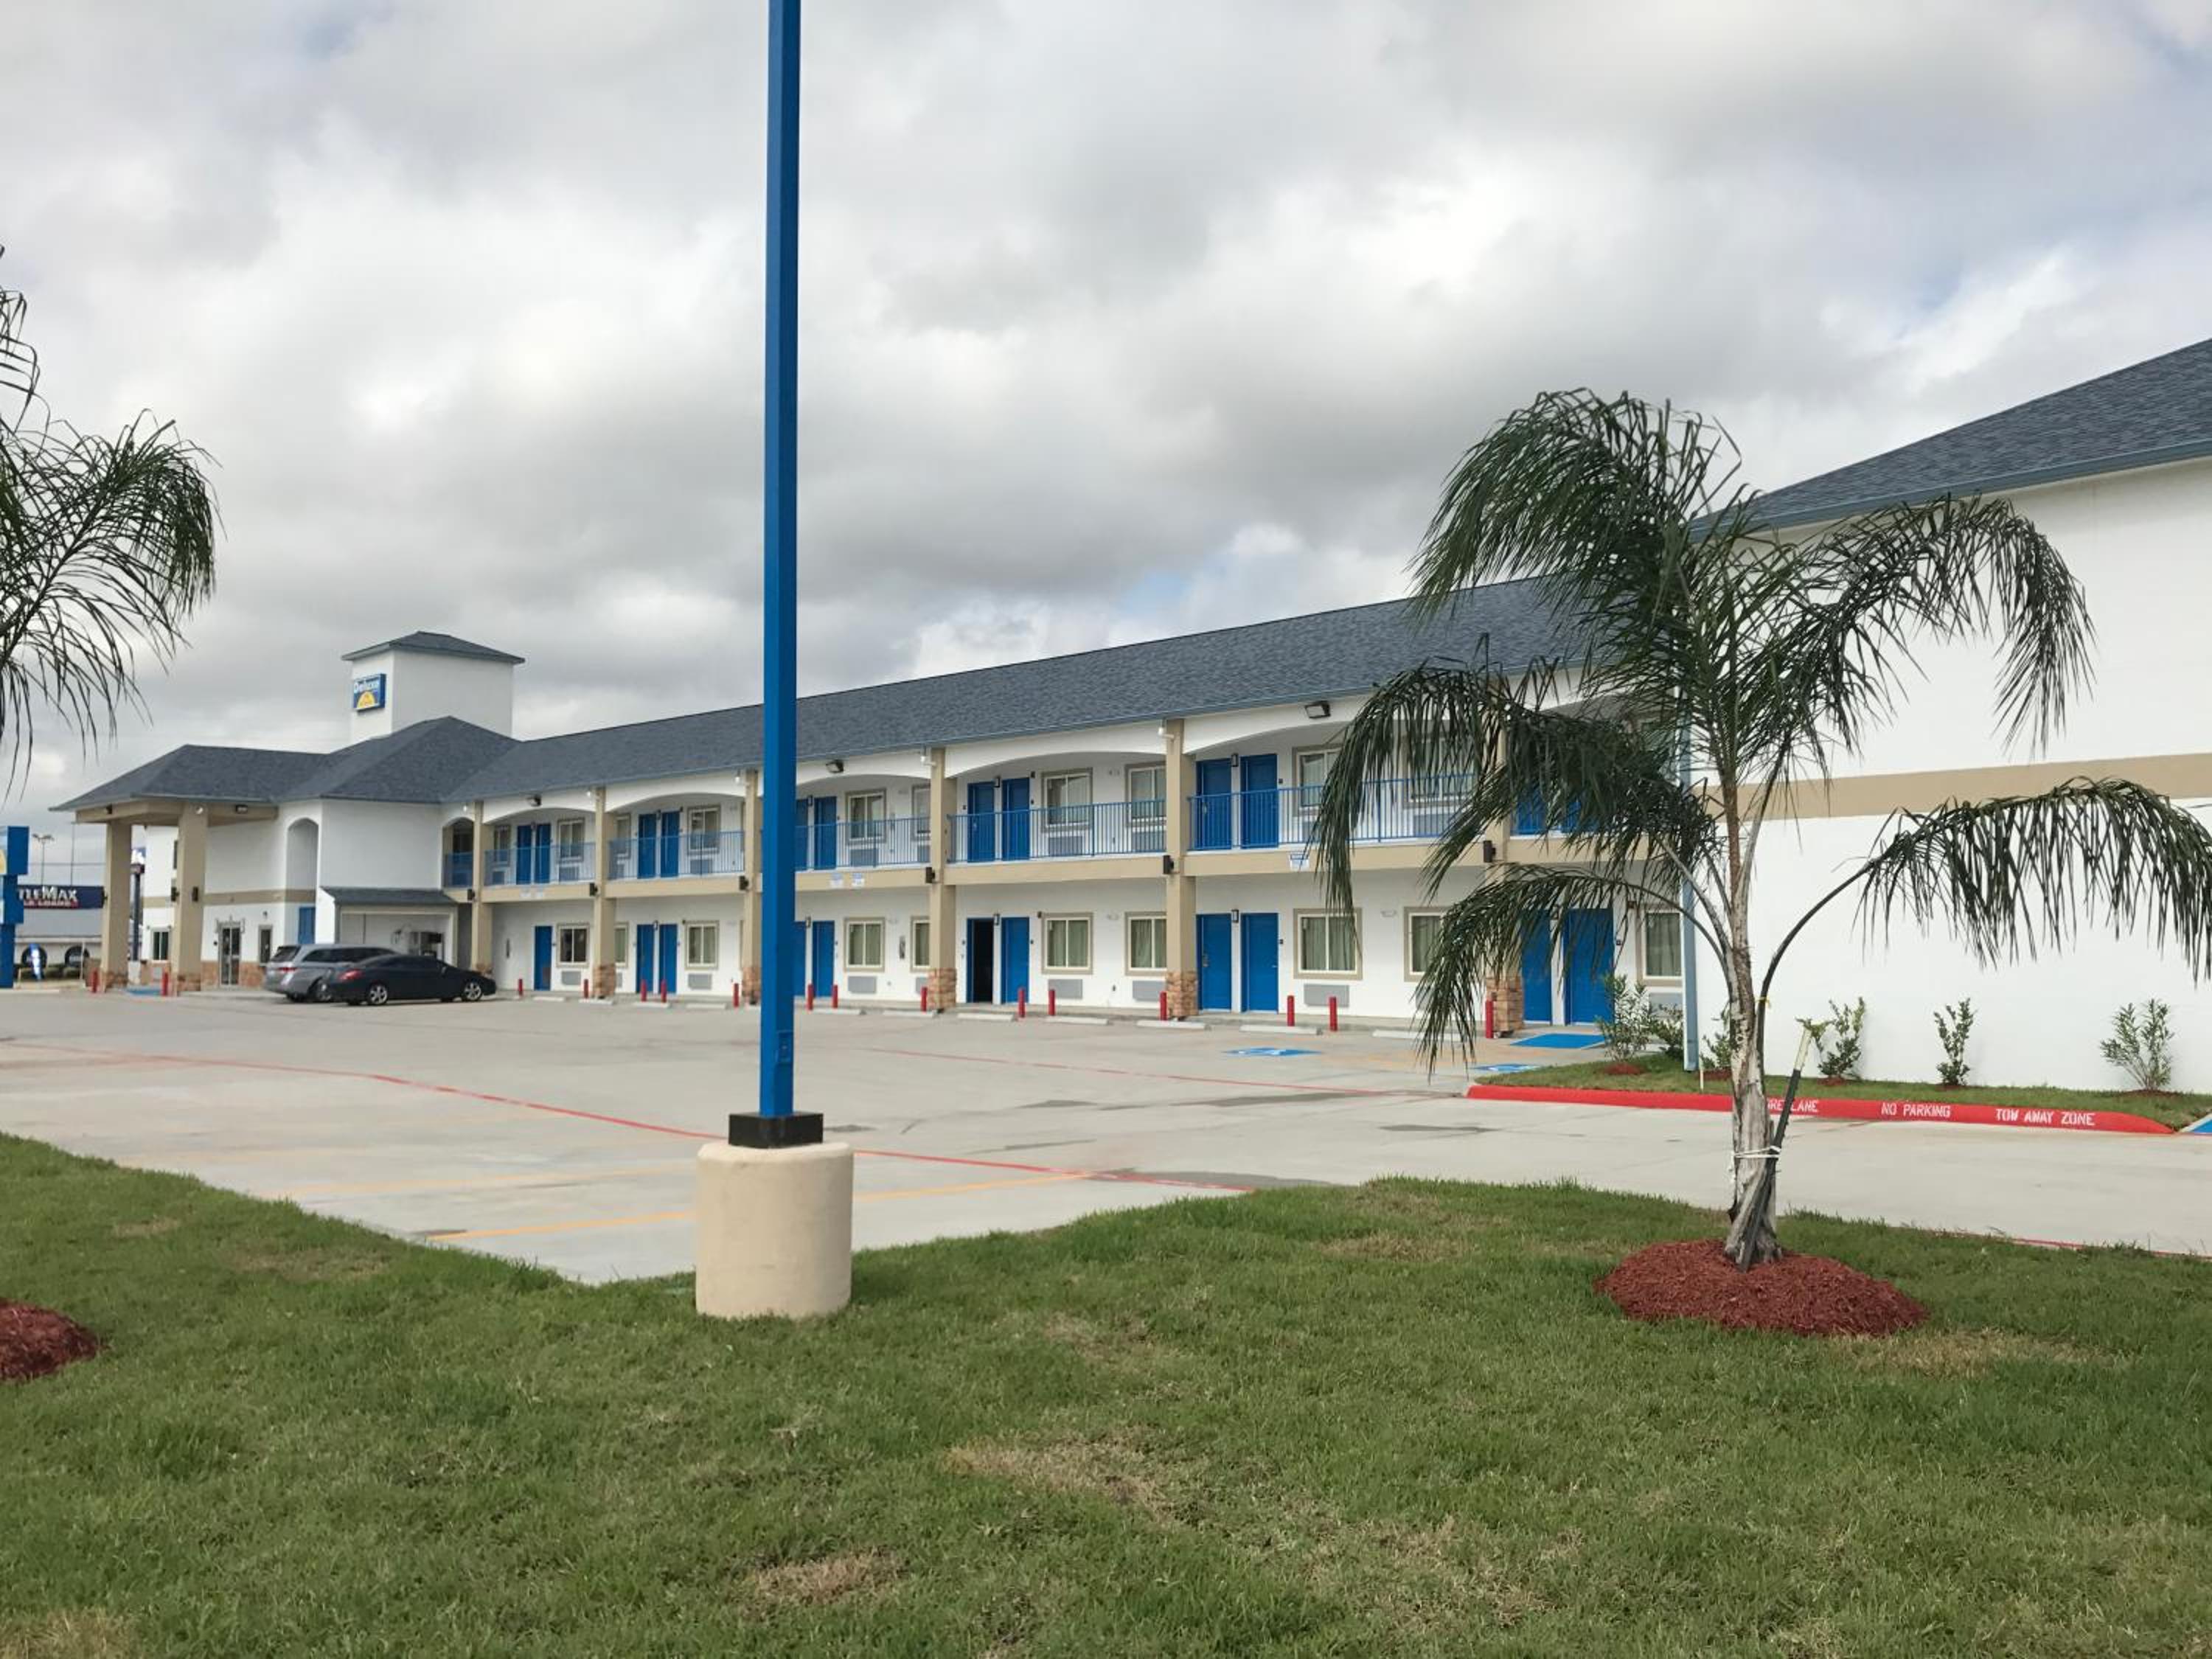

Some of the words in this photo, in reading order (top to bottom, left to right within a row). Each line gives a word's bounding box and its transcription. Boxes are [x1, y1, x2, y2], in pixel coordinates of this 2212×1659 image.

[1767, 1098, 1784, 1110] IRE
[1790, 1099, 1818, 1113] LANE
[1881, 1102, 1897, 1116] NO
[1903, 1104, 1951, 1118] PARKING
[1996, 1108, 2019, 1121] TOW
[2024, 1110, 2054, 1124] AWAY
[2061, 1112, 2096, 1126] ZONE
